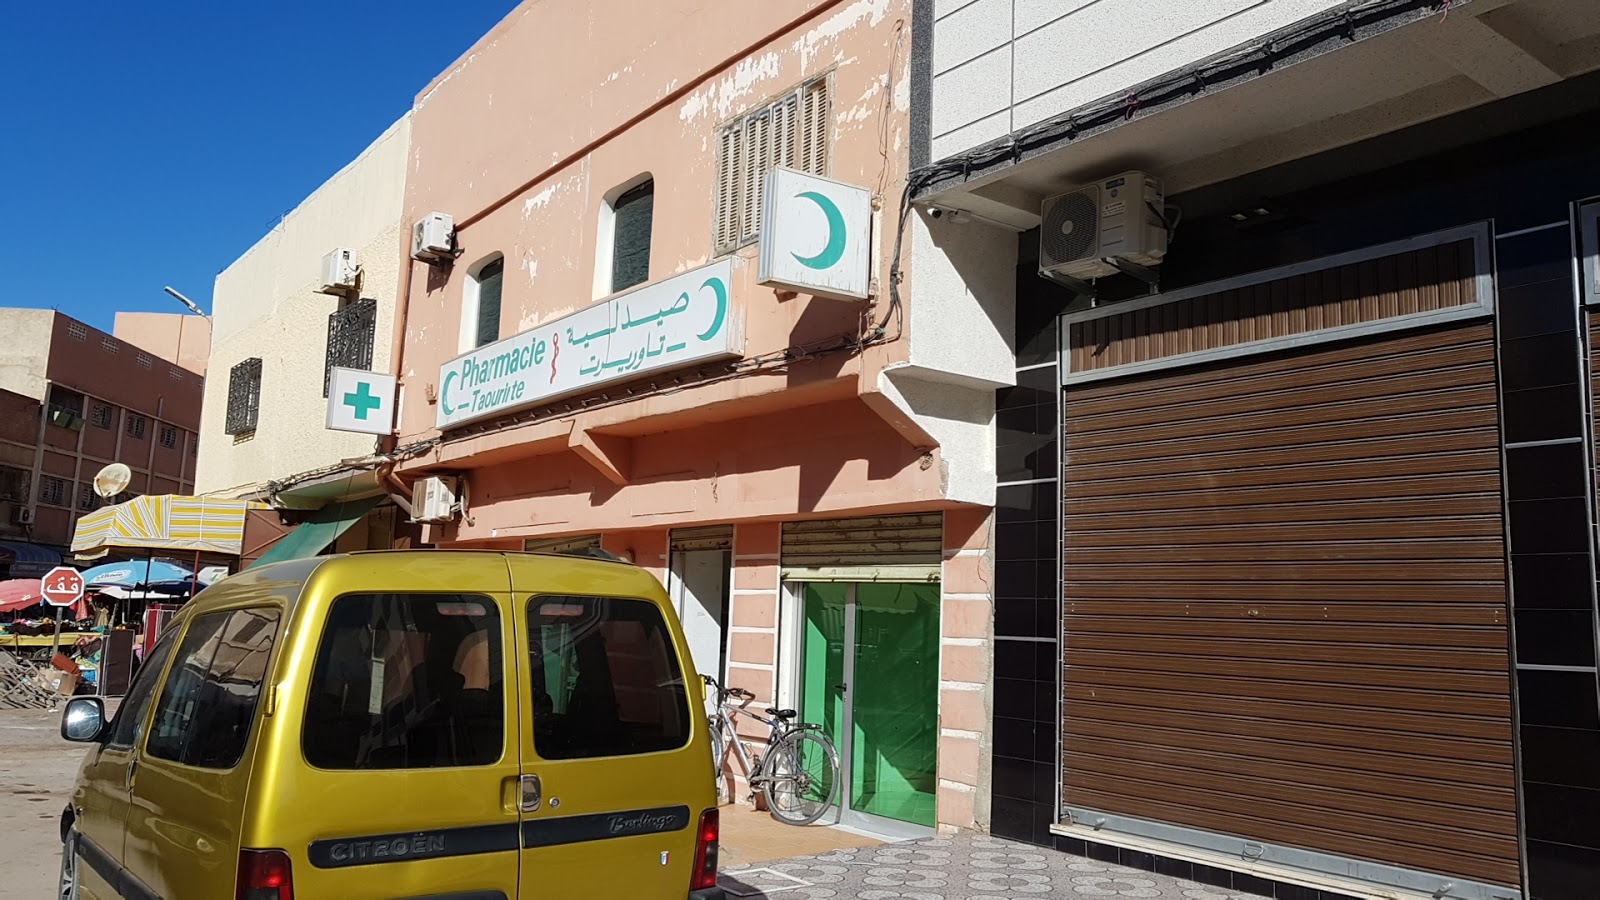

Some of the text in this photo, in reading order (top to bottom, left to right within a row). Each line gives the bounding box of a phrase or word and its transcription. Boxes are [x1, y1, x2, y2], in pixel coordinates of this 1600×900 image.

[567, 292, 689, 348] صيدلية
[460, 338, 546, 390] Pharmacie
[47, 576, 79, 594] قف
[607, 813, 677, 833] Berlingo
[330, 833, 445, 861] CITROËN
